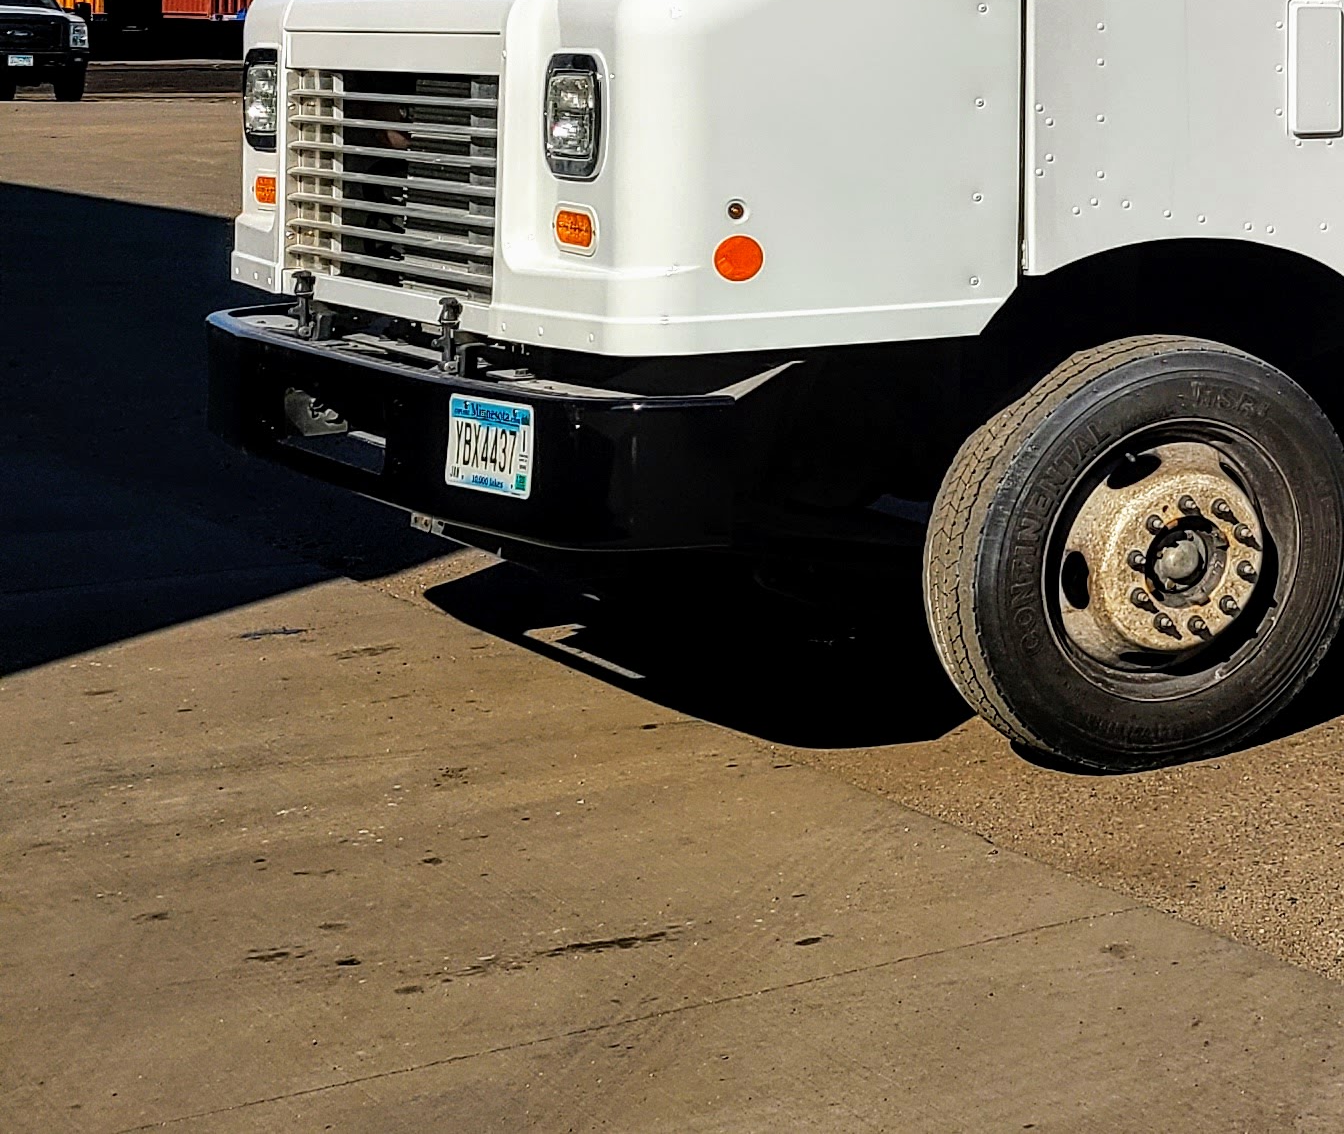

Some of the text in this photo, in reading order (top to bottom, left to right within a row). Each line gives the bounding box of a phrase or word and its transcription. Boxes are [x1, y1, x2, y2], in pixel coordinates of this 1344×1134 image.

[472, 403, 510, 422] Minnesota
[456, 420, 517, 474] YBX4437
[1010, 422, 1111, 657] CONTINENTAL
